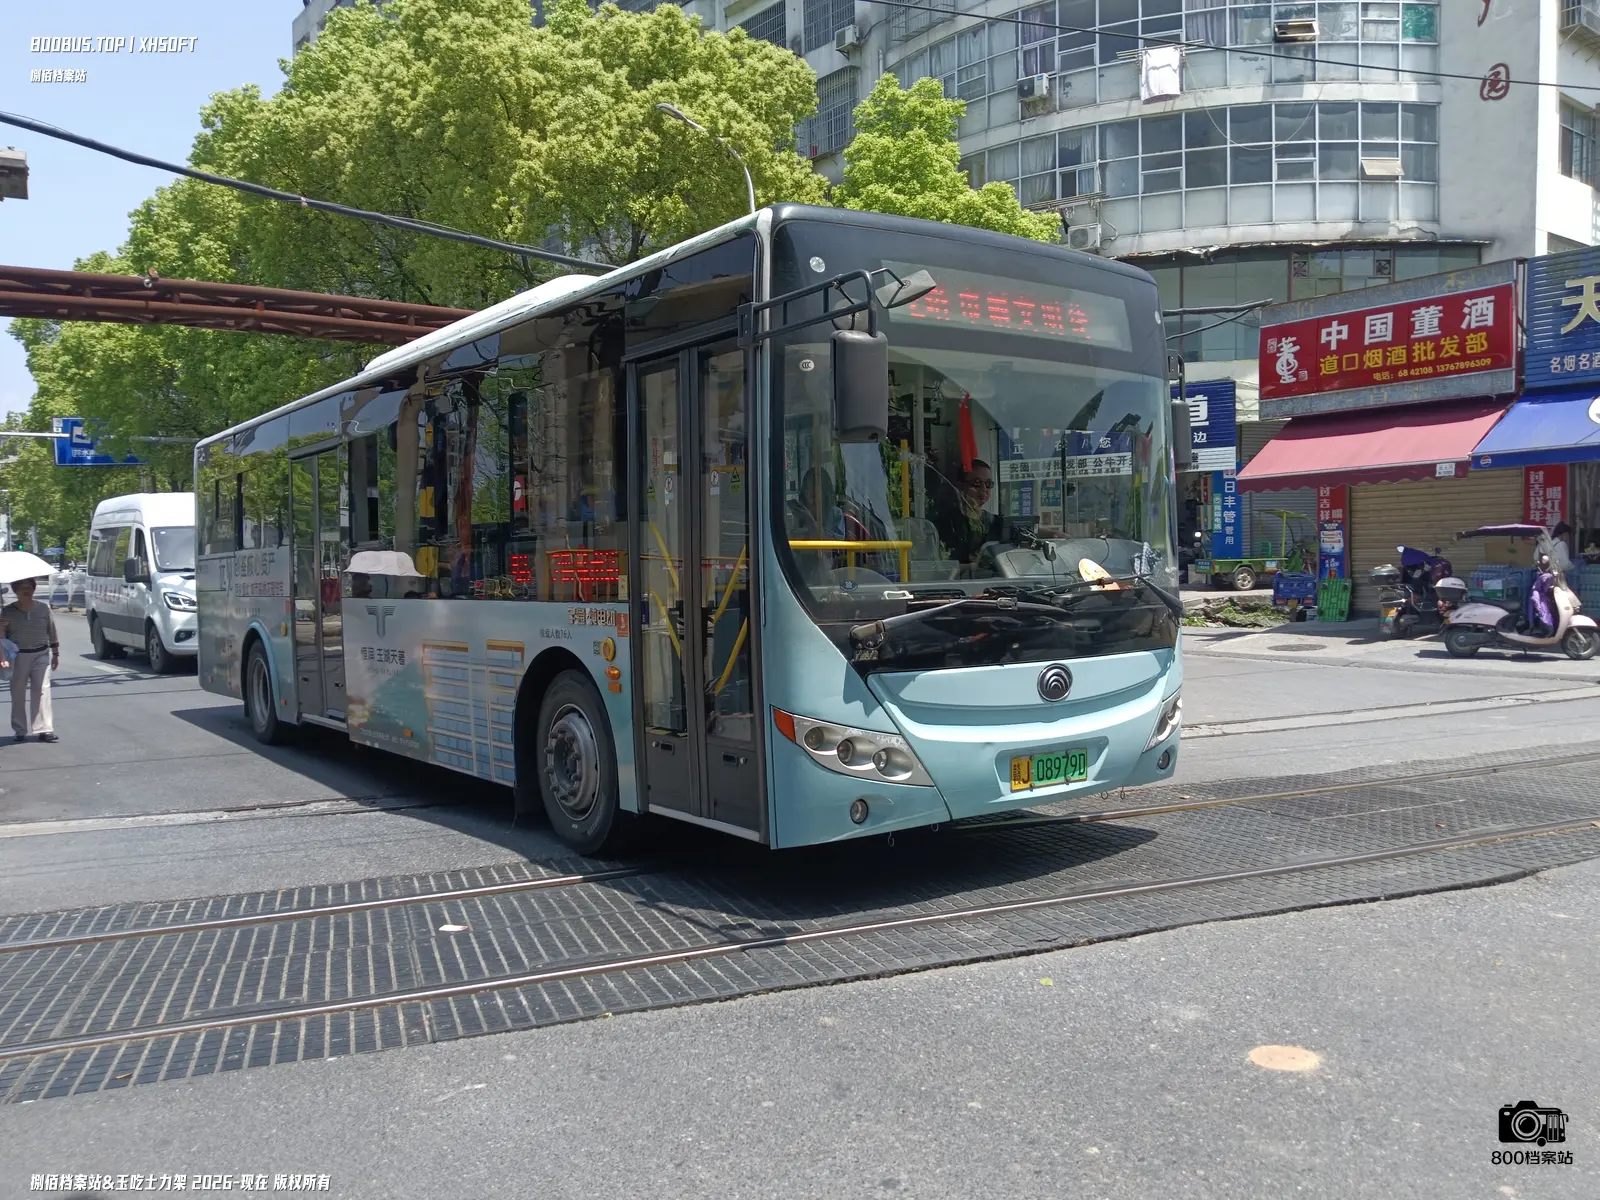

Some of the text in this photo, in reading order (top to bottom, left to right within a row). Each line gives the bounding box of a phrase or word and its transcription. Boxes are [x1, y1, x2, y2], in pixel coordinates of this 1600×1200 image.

[1320, 295, 1495, 350] 中国董酒
[1320, 331, 1488, 376] 道口烟酒批发部
[1436, 358, 1492, 374] 13767896309
[1193, 432, 1208, 443] 边
[1223, 481, 1236, 523] 日丰管
